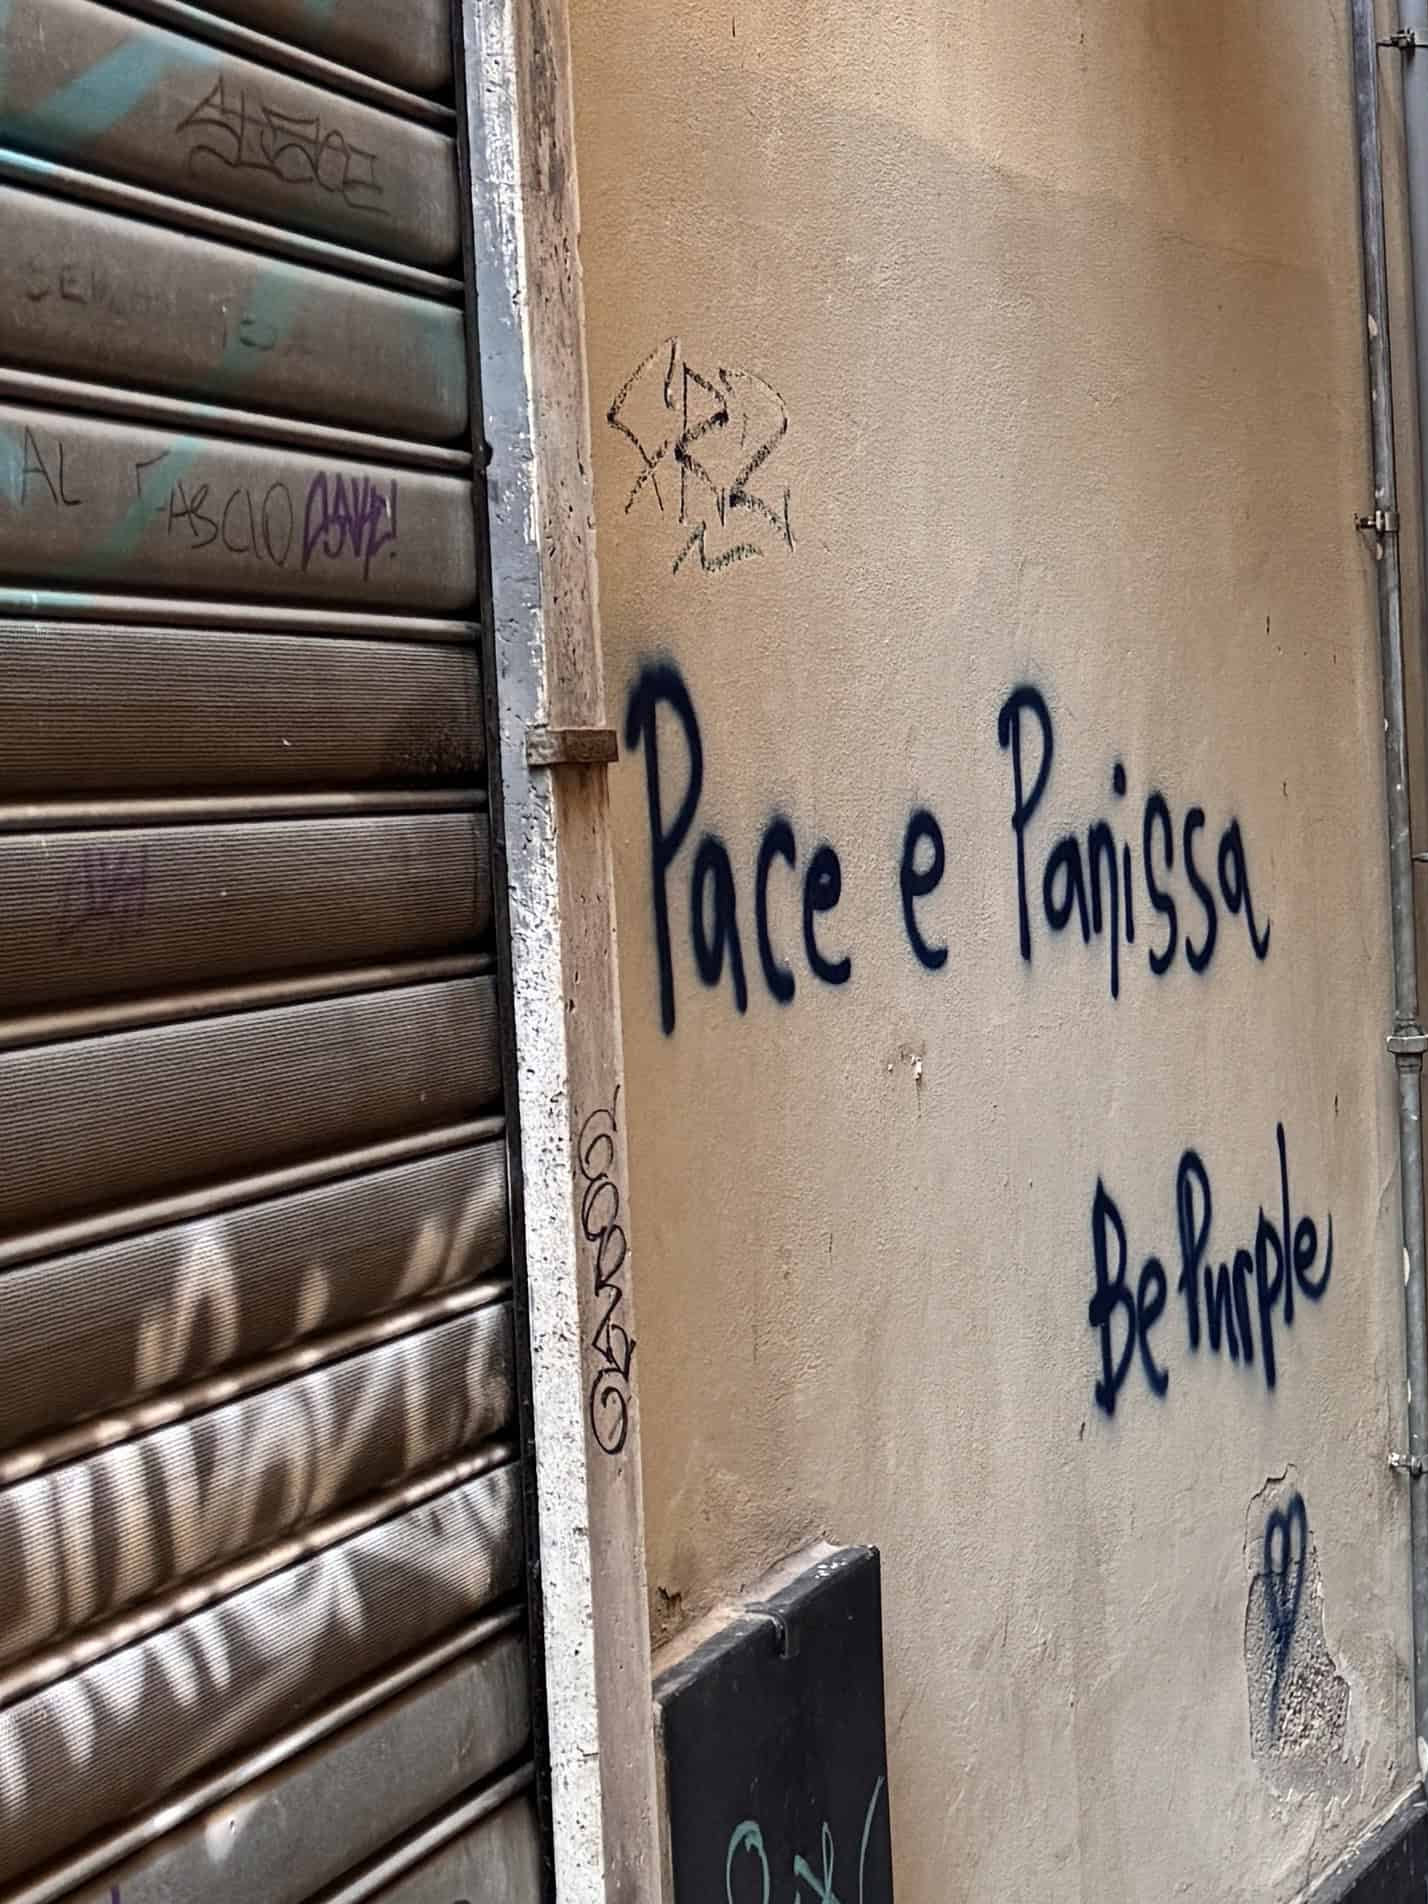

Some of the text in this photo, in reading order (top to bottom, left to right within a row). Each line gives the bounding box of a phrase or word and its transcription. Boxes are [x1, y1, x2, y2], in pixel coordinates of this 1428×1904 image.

[622, 656, 1272, 1040] Pace e Panissa
[1087, 1119, 1335, 1419] Be Purple
